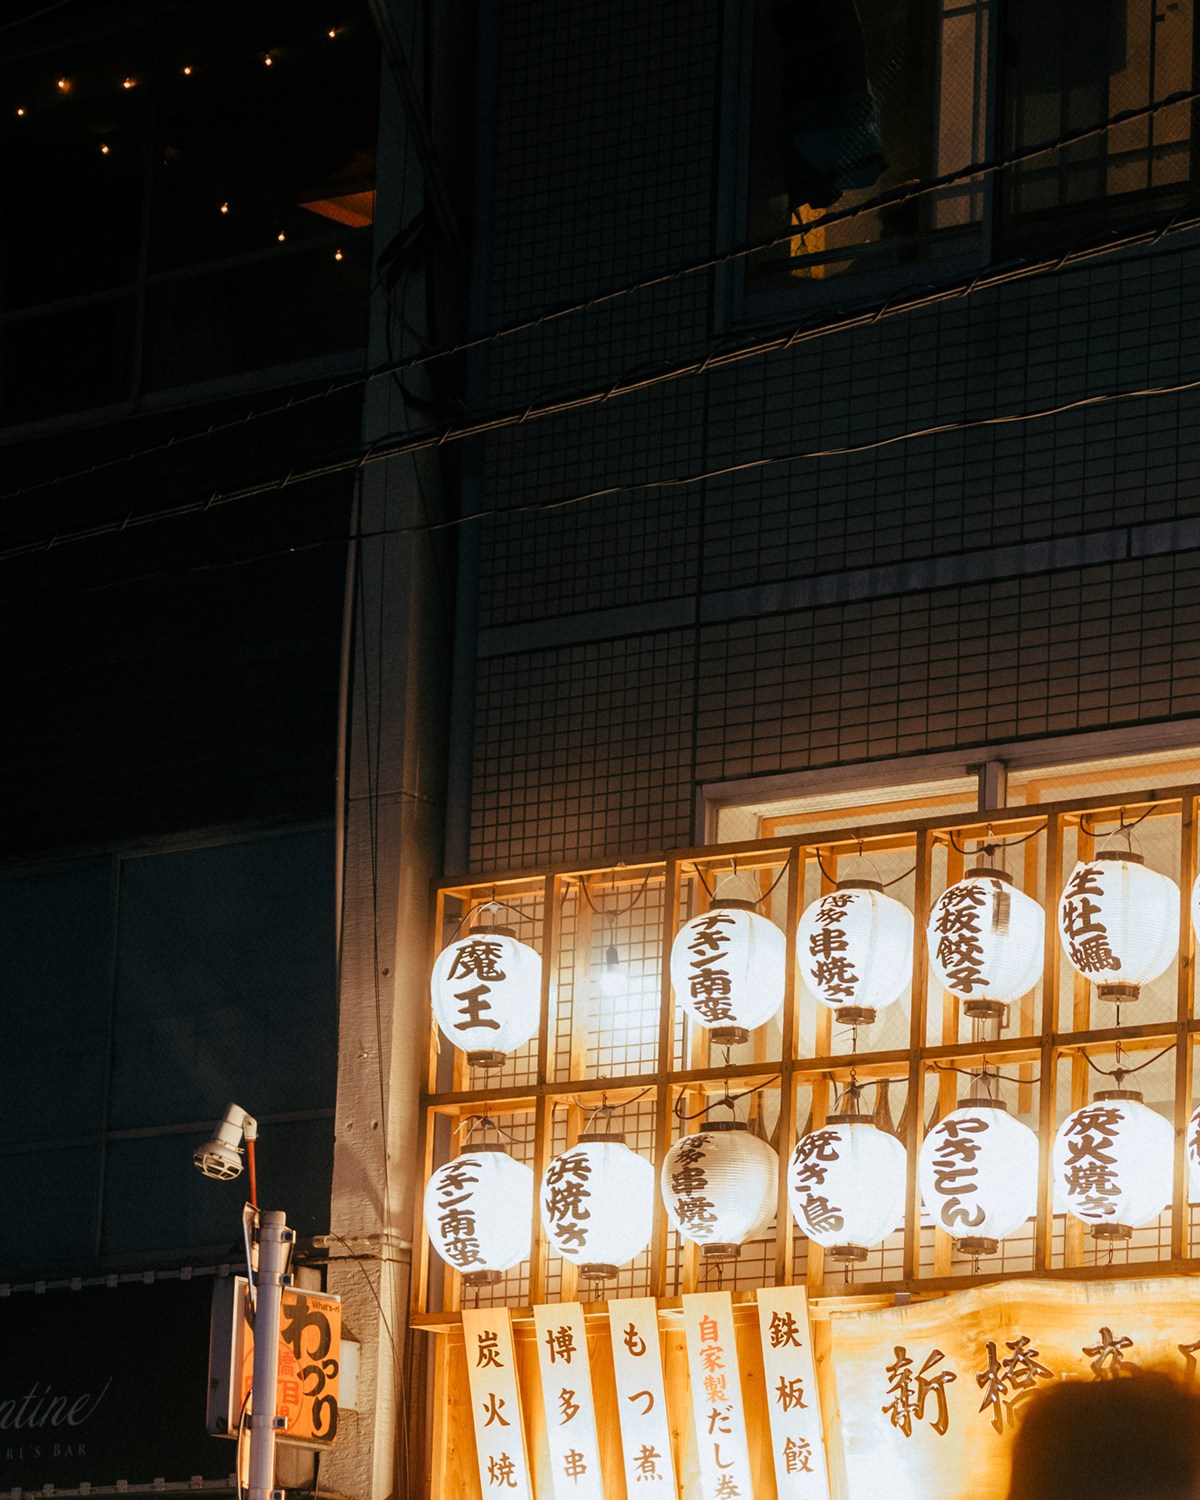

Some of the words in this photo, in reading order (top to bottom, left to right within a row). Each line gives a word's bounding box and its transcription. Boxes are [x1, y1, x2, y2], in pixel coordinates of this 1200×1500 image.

[447, 940, 507, 1031] 魔王
[688, 914, 737, 1022] チキン南蛮
[809, 893, 860, 1004] 博多串焼き
[934, 884, 990, 994] 鉄板餃子
[435, 1159, 487, 1267] チキン南蛮
[545, 1151, 592, 1255] 浜焼き
[793, 1130, 846, 1235] 焼き鳥
[932, 1117, 989, 1229] やきとん
[1064, 1106, 1124, 1219] 炭火焼き
